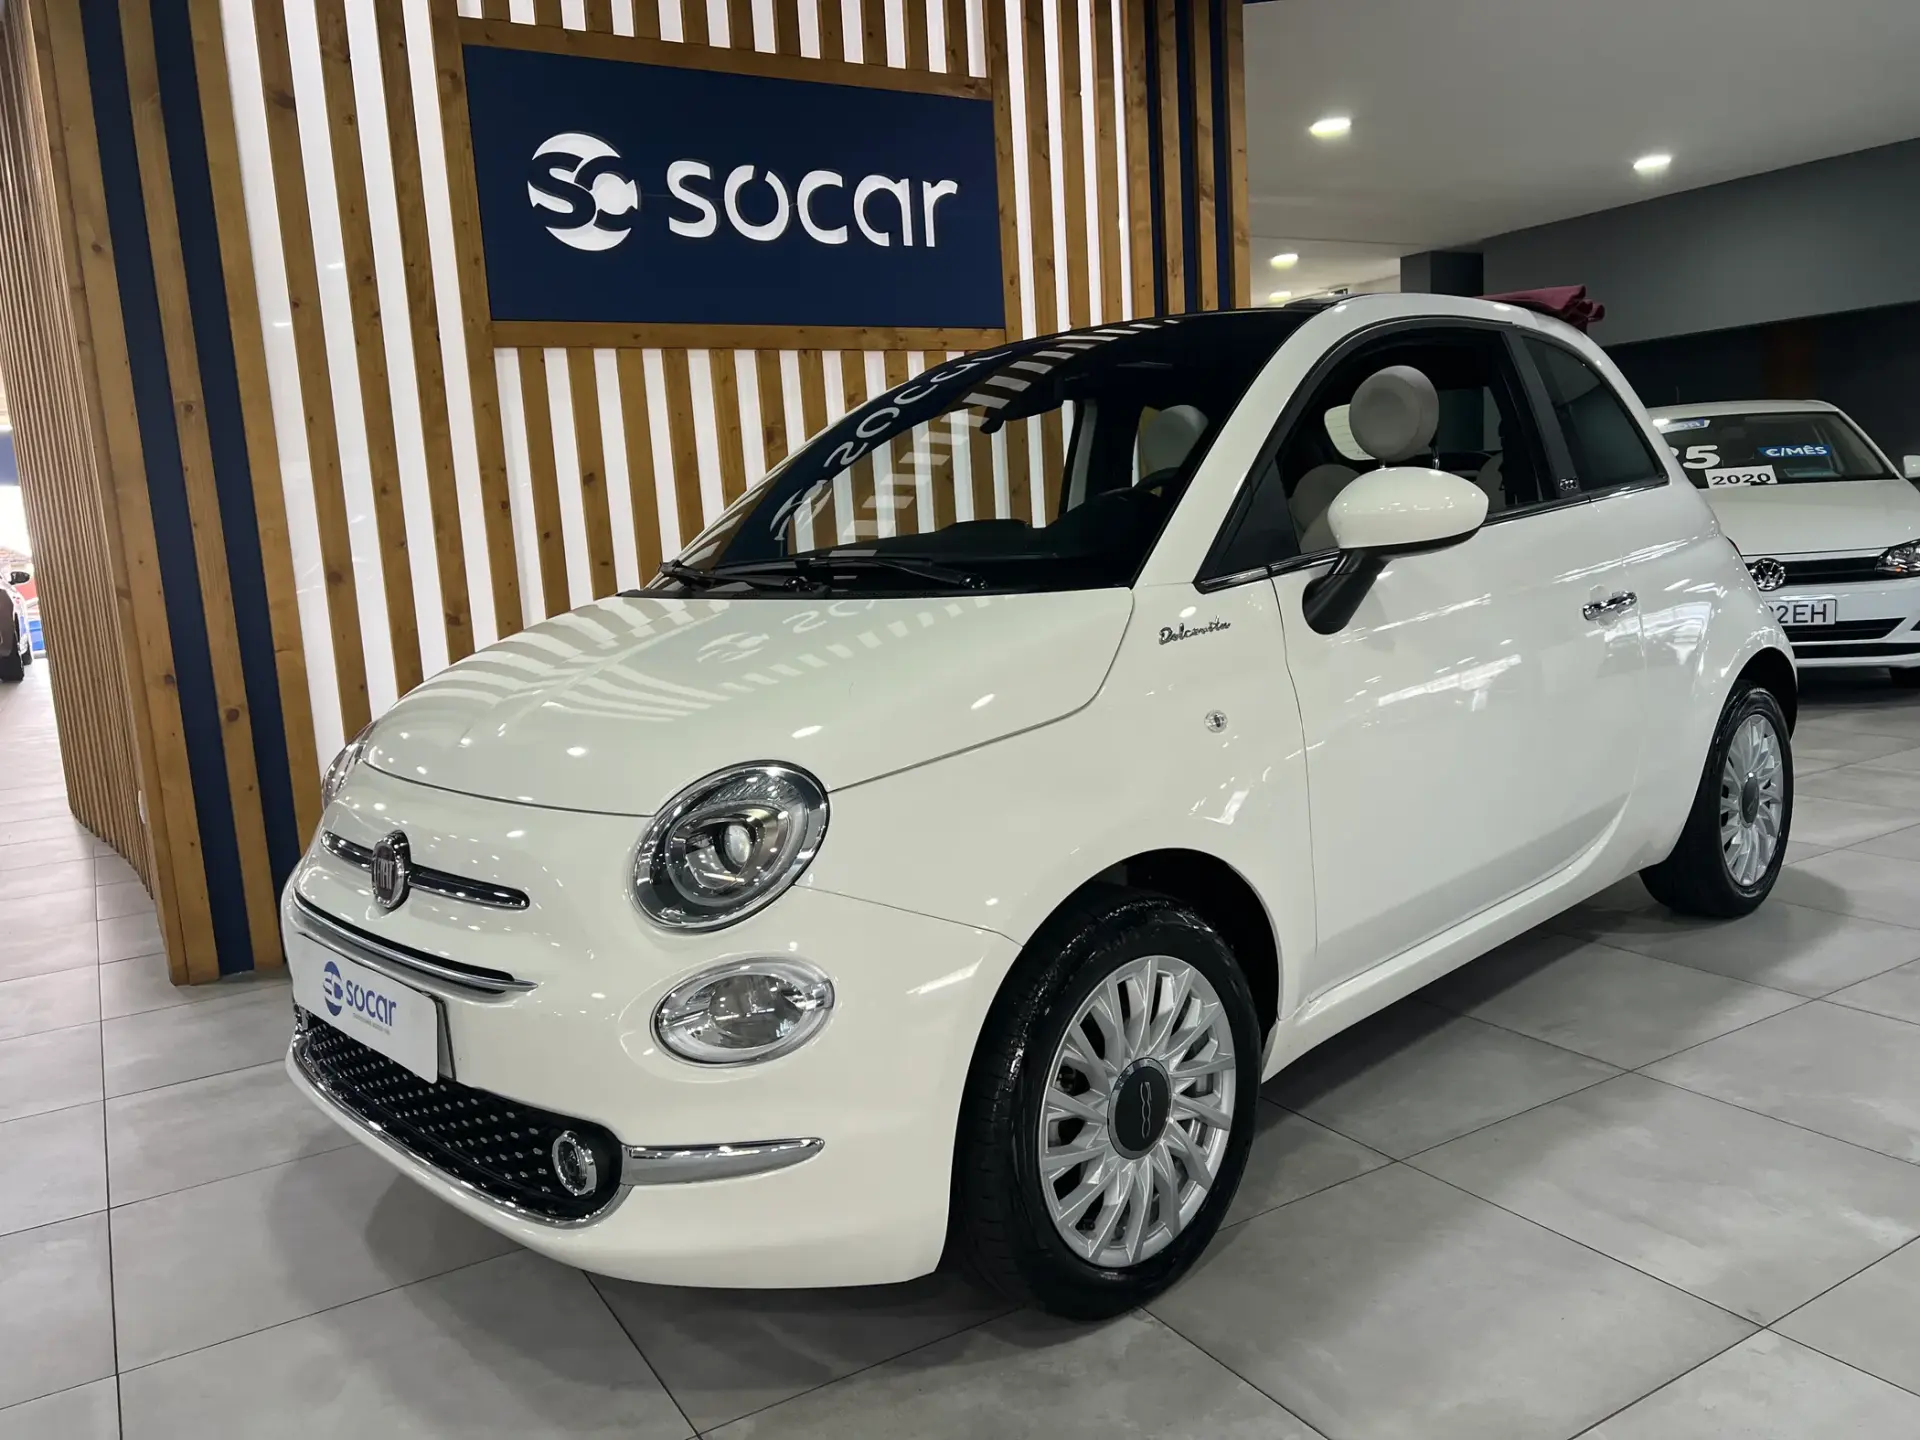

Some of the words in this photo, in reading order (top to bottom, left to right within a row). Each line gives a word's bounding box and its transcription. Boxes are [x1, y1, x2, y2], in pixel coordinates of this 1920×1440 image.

[1669, 445, 1720, 469] 5
[1765, 445, 1827, 457] C/MÊS
[1711, 472, 1771, 486] 2020
